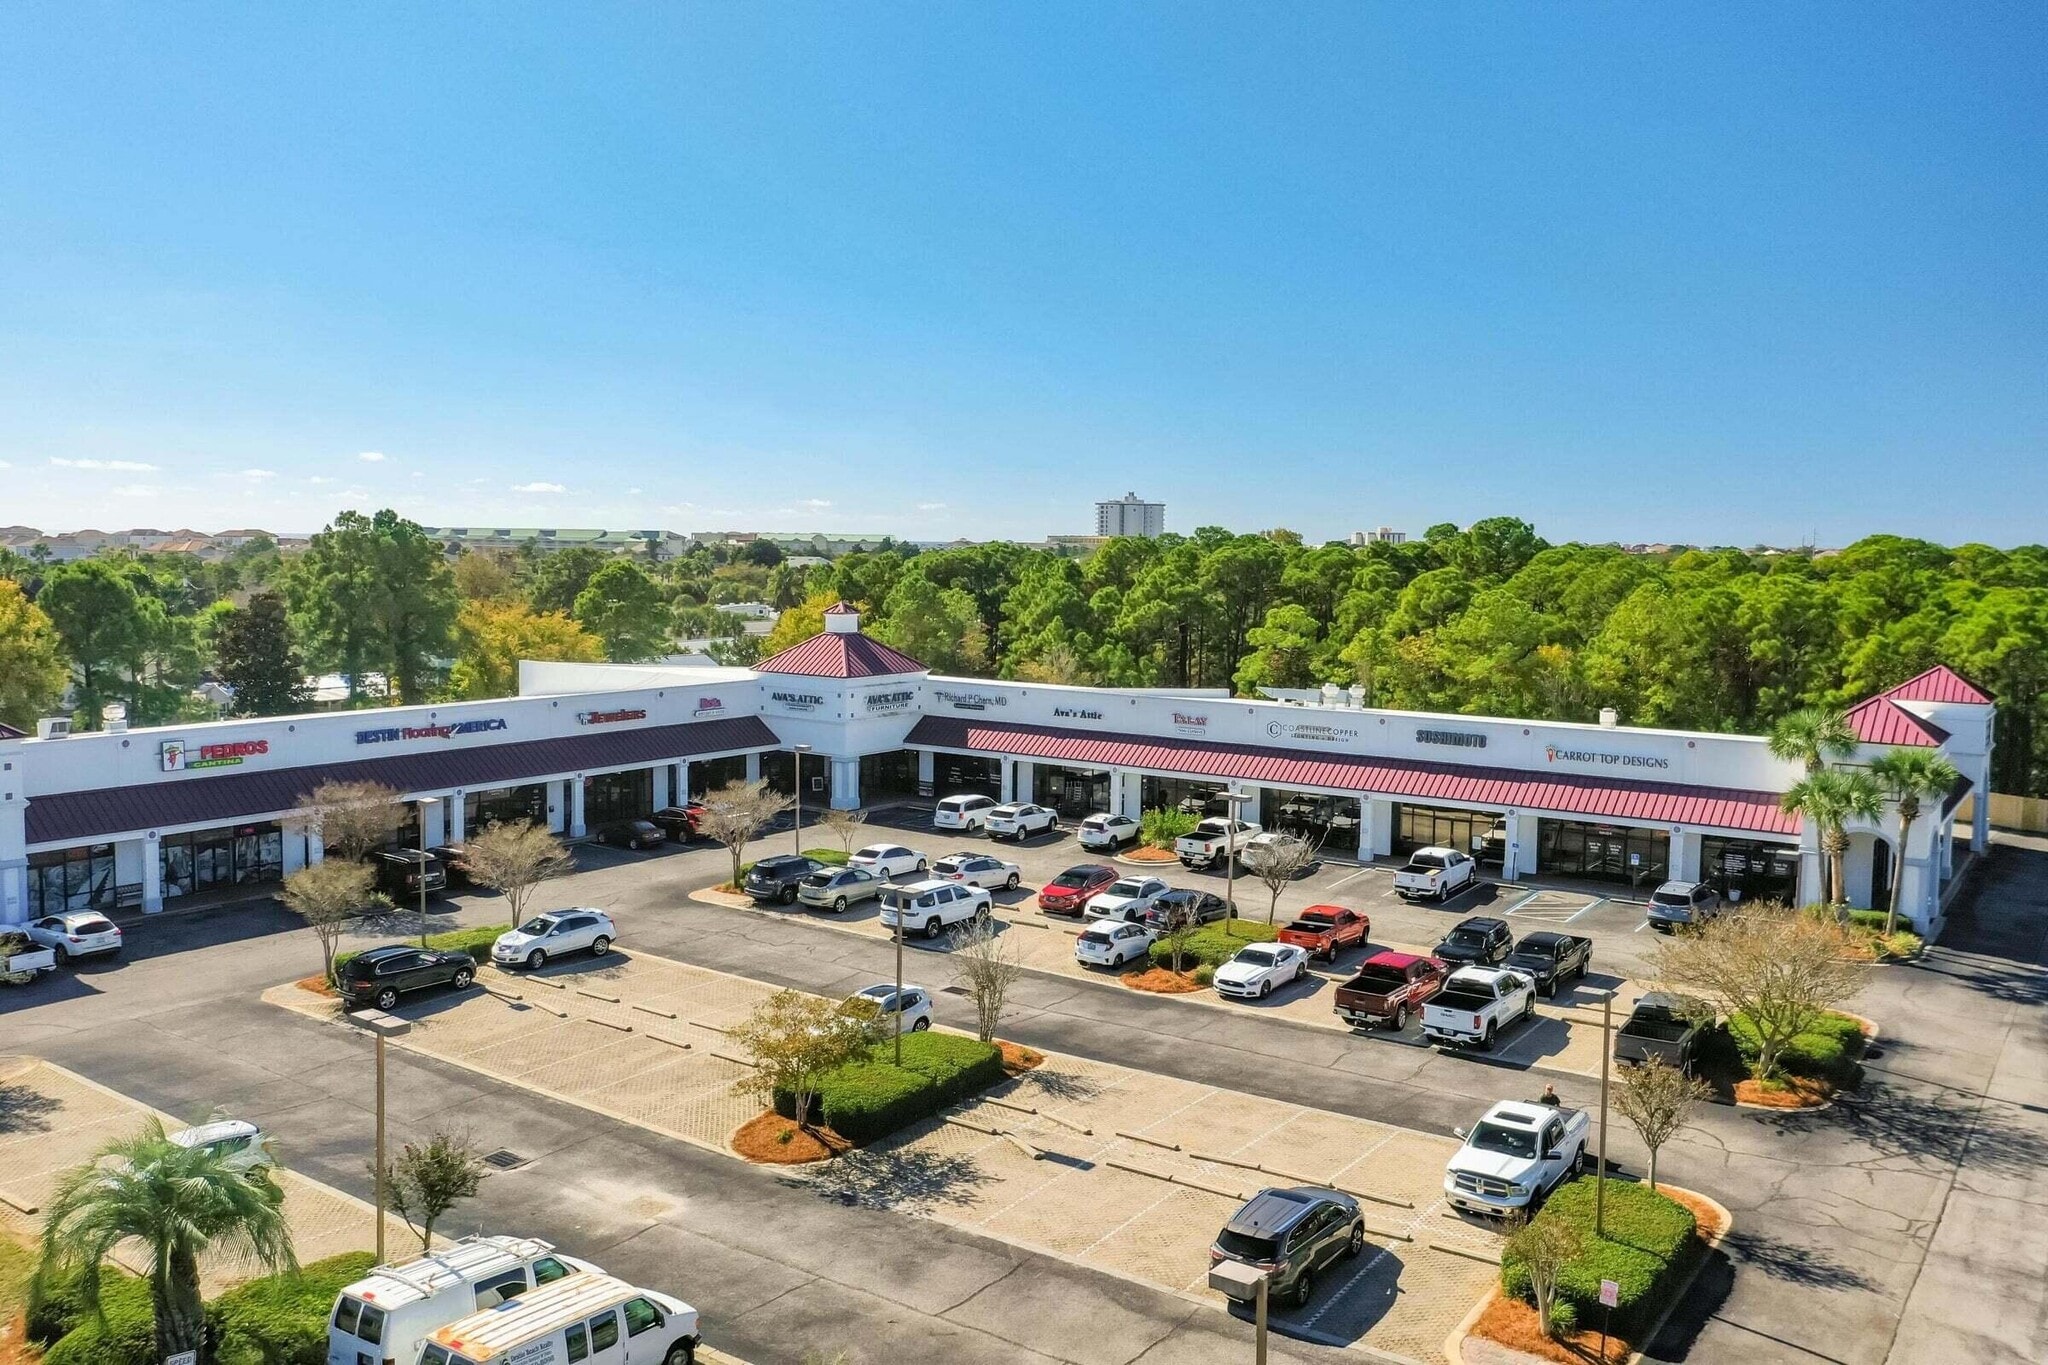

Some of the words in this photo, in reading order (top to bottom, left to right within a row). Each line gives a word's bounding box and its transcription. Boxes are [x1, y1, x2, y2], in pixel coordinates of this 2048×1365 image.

[771, 692, 796, 702] AVA'S
[797, 694, 824, 705] ATTIC
[891, 691, 914, 702] ATTIC
[994, 696, 1007, 706] MD
[869, 702, 909, 712] FURNITURE
[1053, 707, 1078, 718] Ava's
[1079, 709, 1103, 720] Attic
[356, 728, 400, 745] DESTIN
[1415, 729, 1488, 748] SUSHIMOTO
[200, 739, 269, 760] PEDROS
[193, 757, 241, 768] CANTINA
[1555, 750, 1597, 763] CARROT
[1598, 753, 1620, 765] TOP
[1622, 755, 1669, 769] DESIGNS
